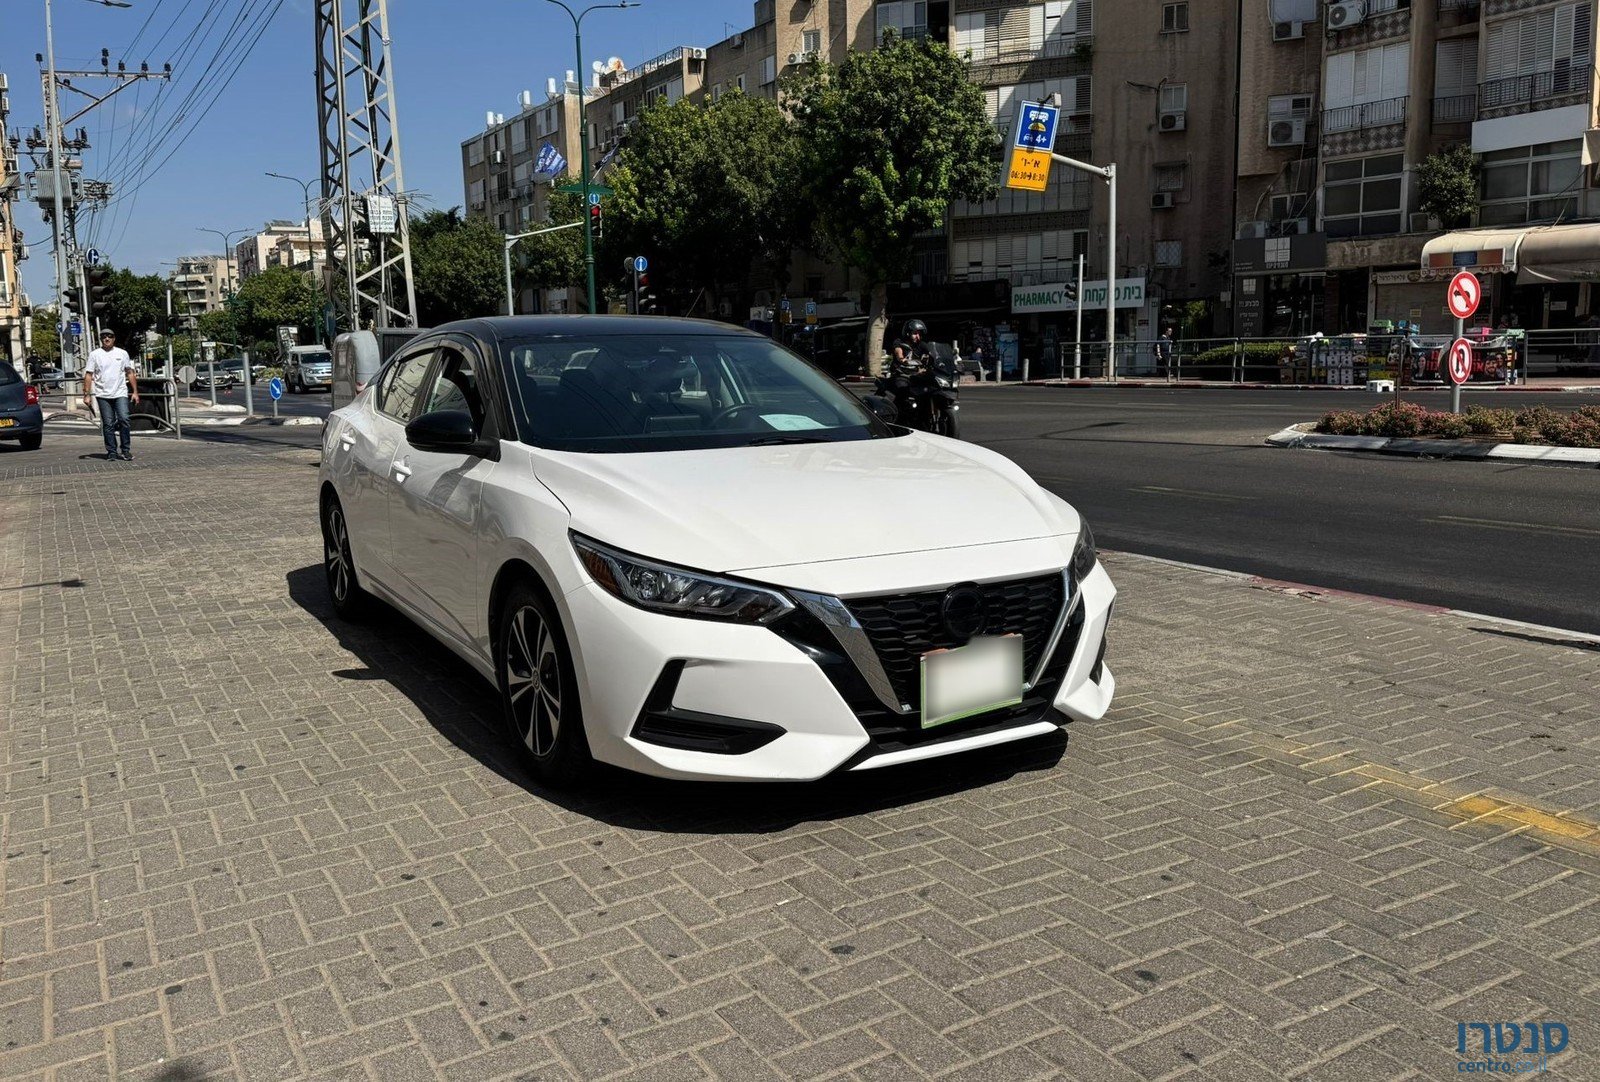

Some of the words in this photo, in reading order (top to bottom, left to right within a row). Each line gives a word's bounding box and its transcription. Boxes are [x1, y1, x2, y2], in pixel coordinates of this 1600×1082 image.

[1013, 290, 1064, 307] PHARMACY
[1083, 288, 1121, 306] מקחת
[1122, 285, 1142, 301] בית
